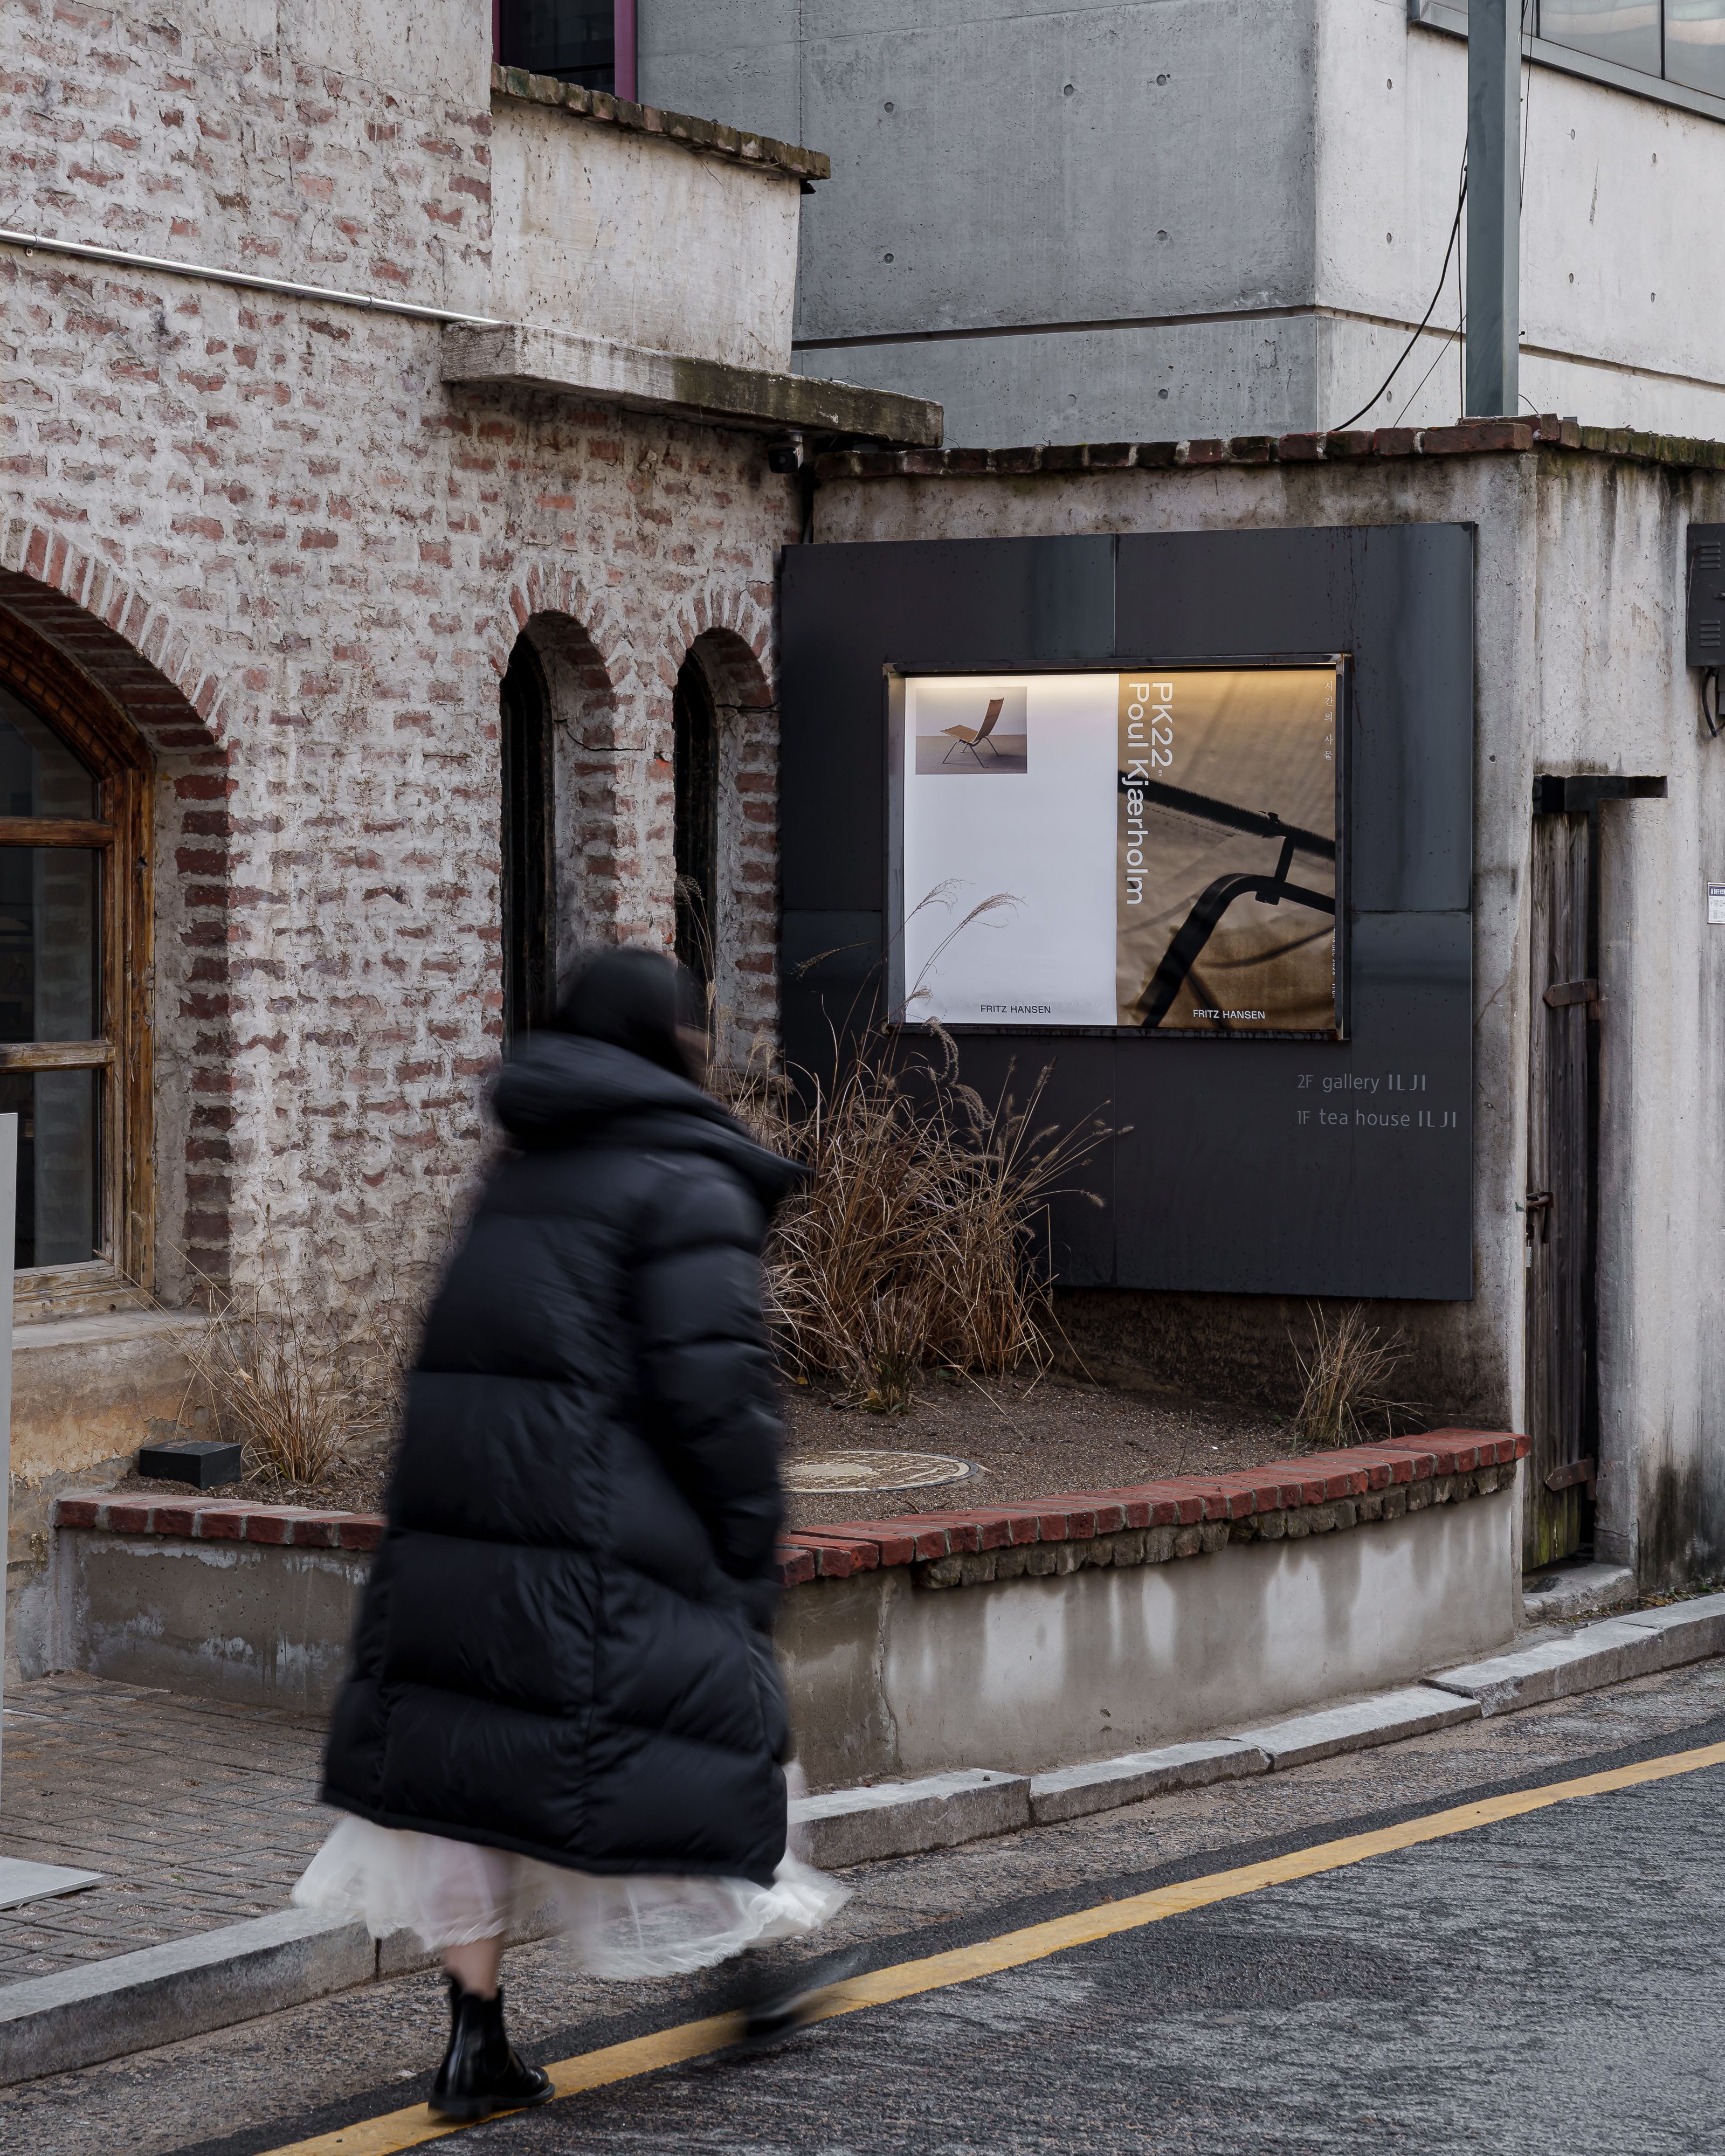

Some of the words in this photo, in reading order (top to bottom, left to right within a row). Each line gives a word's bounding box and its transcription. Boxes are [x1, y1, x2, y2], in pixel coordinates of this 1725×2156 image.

[1324, 680, 1334, 723] 시간의
[1128, 683, 1149, 747] Poul
[1151, 682, 1173, 767] PK22
[1323, 734, 1334, 761] 사물
[1158, 769, 1163, 777] BY
[1122, 759, 1149, 904] Kjærholm
[1011, 1005, 1051, 1013] HANSEN
[1193, 1009, 1219, 1018] FRITZ
[1223, 1011, 1265, 1019] HANSEN
[1298, 1074, 1314, 1088] 2F
[1323, 1073, 1379, 1094] gallery
[1389, 1074, 1425, 1091] ILJI
[1297, 1111, 1311, 1124] 1F
[1319, 1108, 1348, 1125] tea
[1356, 1109, 1410, 1127] house
[1419, 1111, 1456, 1128] ILJI
